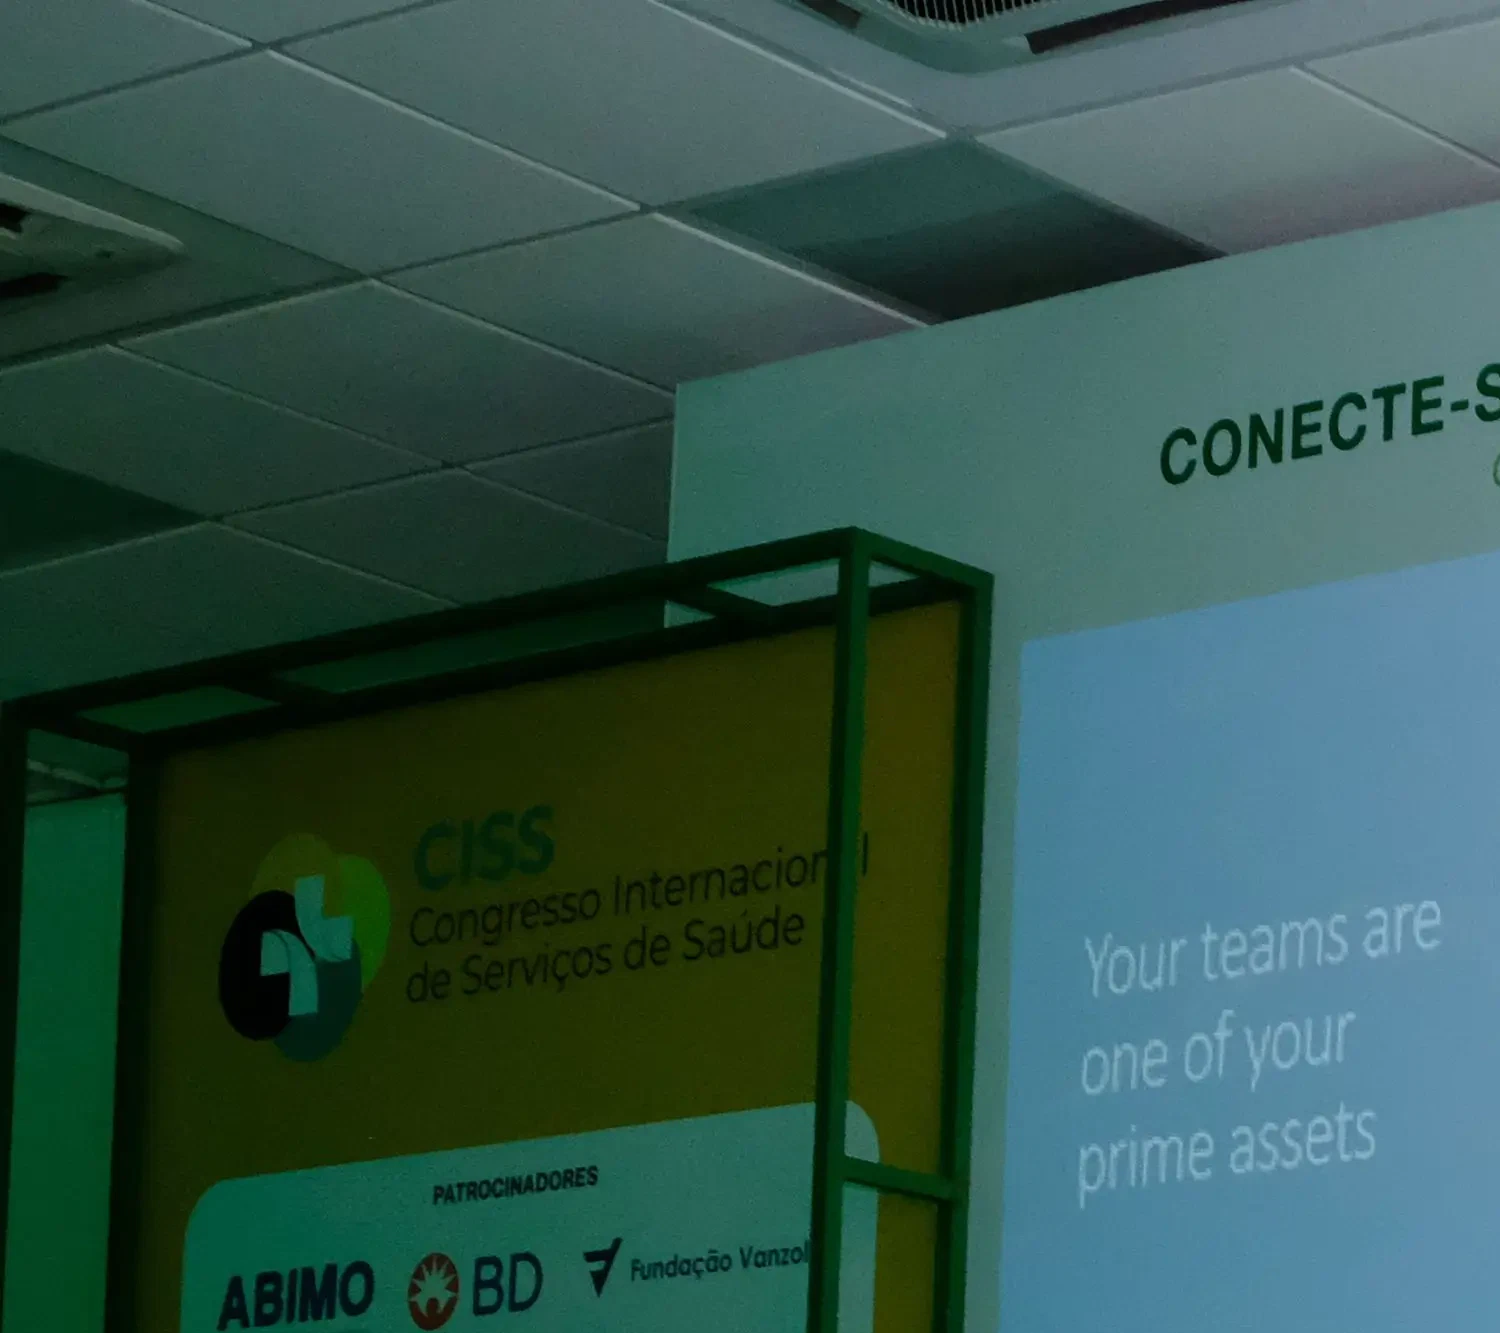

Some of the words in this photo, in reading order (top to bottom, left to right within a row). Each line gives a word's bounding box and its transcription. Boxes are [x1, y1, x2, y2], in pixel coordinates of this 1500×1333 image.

[409, 887, 603, 949] Congresso
[612, 830, 870, 918] Internacionl
[413, 803, 557, 892] CISS
[406, 959, 452, 1004] de
[461, 937, 613, 996] Serviços
[623, 923, 672, 971] de
[683, 903, 806, 962] Saúde
[1084, 931, 1188, 999] Your
[1199, 912, 1349, 981] teams
[1363, 898, 1443, 959] are
[1081, 1036, 1169, 1095] one
[1183, 1007, 1236, 1082] of
[1243, 1009, 1357, 1092] your
[432, 1163, 599, 1206] PATROCINADORES
[1076, 1122, 1215, 1210] prime
[1228, 1100, 1377, 1174] assets
[215, 1260, 375, 1332] ABIMO
[471, 1250, 544, 1318] BD
[630, 1248, 733, 1283] Fundação
[738, 1237, 813, 1269] Vanzol
